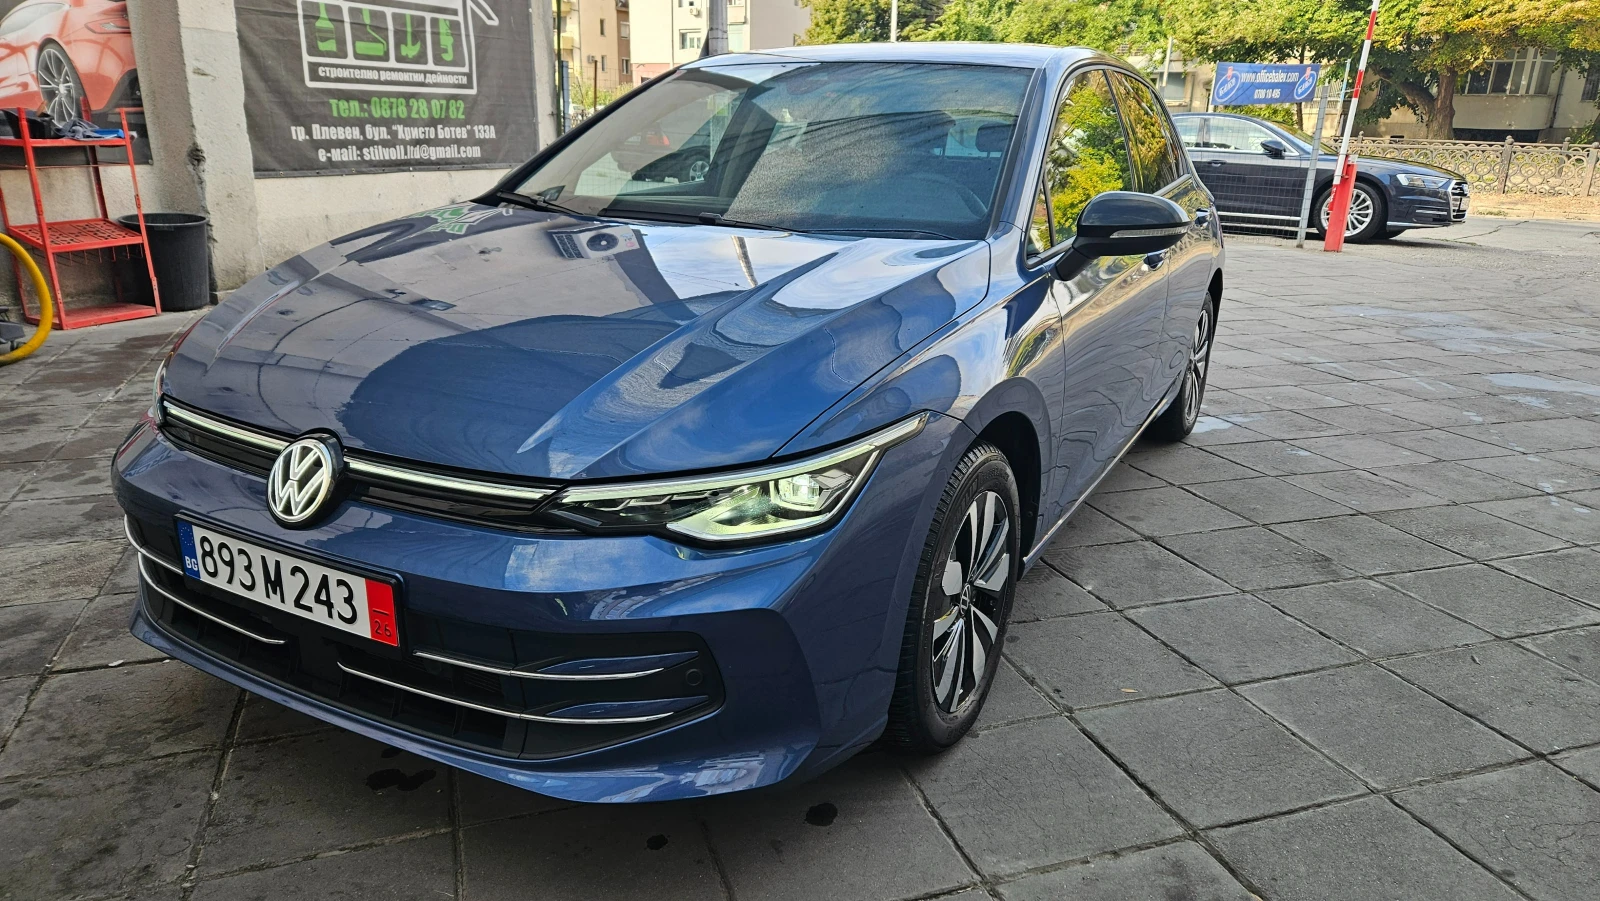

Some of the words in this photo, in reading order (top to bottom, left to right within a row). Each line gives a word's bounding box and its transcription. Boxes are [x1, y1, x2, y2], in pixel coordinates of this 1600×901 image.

[318, 66, 379, 80] строително
[379, 70, 425, 82] ремонтни
[425, 72, 468, 85] дейности
[1240, 70, 1299, 82] www.officebalev.com
[370, 96, 408, 119] 0878
[409, 98, 429, 119] 28
[430, 98, 447, 119] 07
[448, 99, 466, 119] 82
[290, 125, 310, 142] гр.
[311, 123, 364, 141] Плевен,
[364, 123, 391, 141] бул.
[362, 144, 482, 161] stilvoll.ltd@gmail.com
[185, 556, 198, 571] BG
[199, 535, 256, 593] 893
[289, 565, 358, 625] 243
[374, 619, 393, 638] 26
